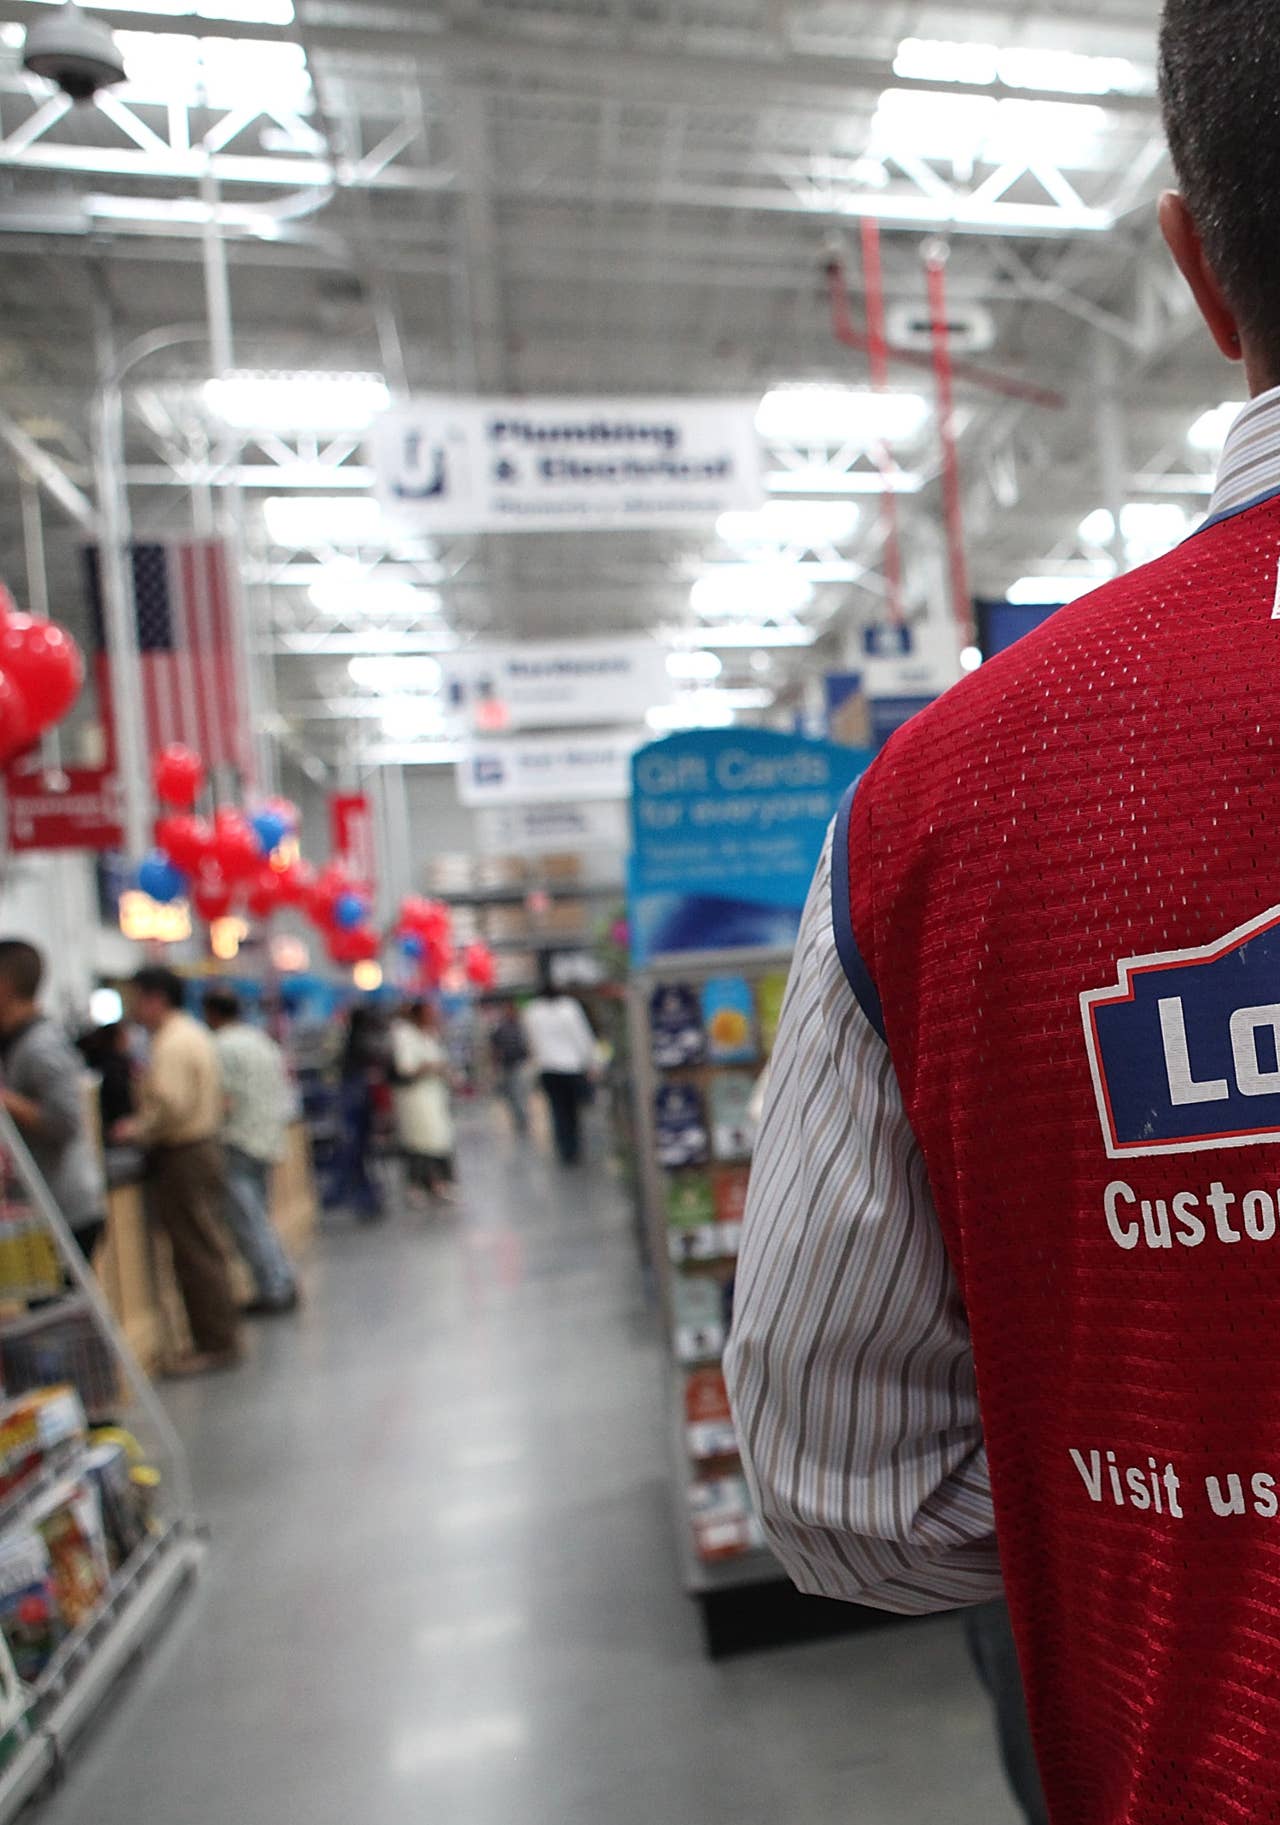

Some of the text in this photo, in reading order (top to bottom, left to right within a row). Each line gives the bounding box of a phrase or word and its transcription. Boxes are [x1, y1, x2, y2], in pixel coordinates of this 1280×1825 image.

[490, 418, 680, 451] Plumbing
[539, 454, 732, 482] Electrical
[637, 748, 829, 793] Gift Cards
[639, 793, 830, 830] for everyone
[1069, 1448, 1184, 1519] Visit
[1205, 1472, 1279, 1518] us
